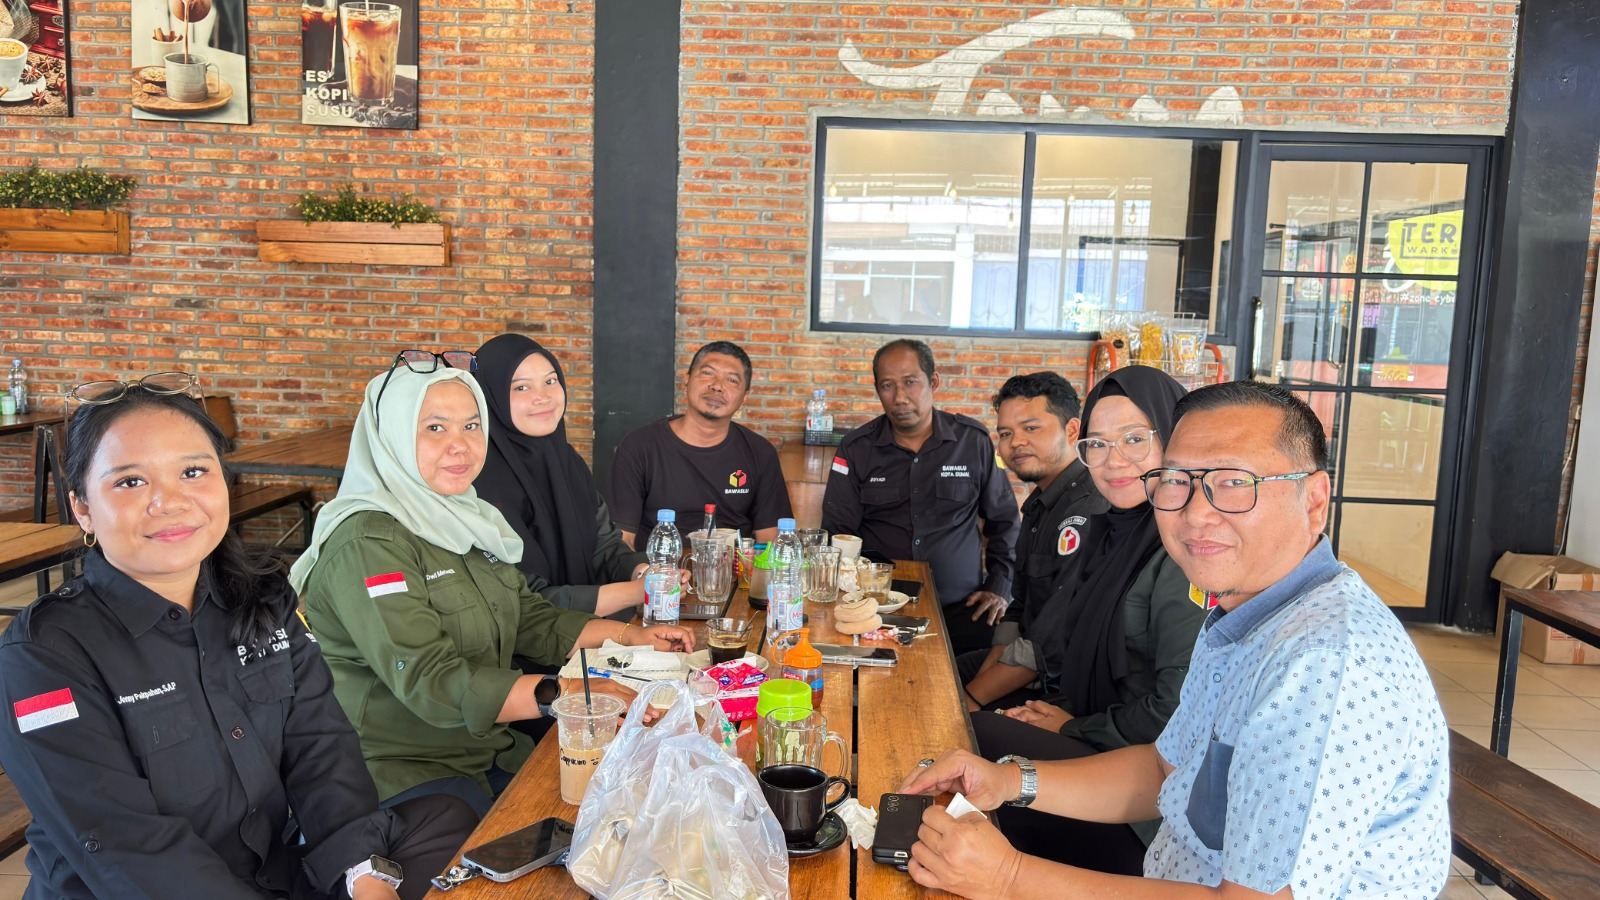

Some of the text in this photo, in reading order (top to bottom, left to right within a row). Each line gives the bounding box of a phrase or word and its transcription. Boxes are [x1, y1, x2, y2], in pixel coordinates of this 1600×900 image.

[305, 70, 328, 83] ES
[305, 87, 348, 101] KOPI
[306, 104, 353, 118] SUSU
